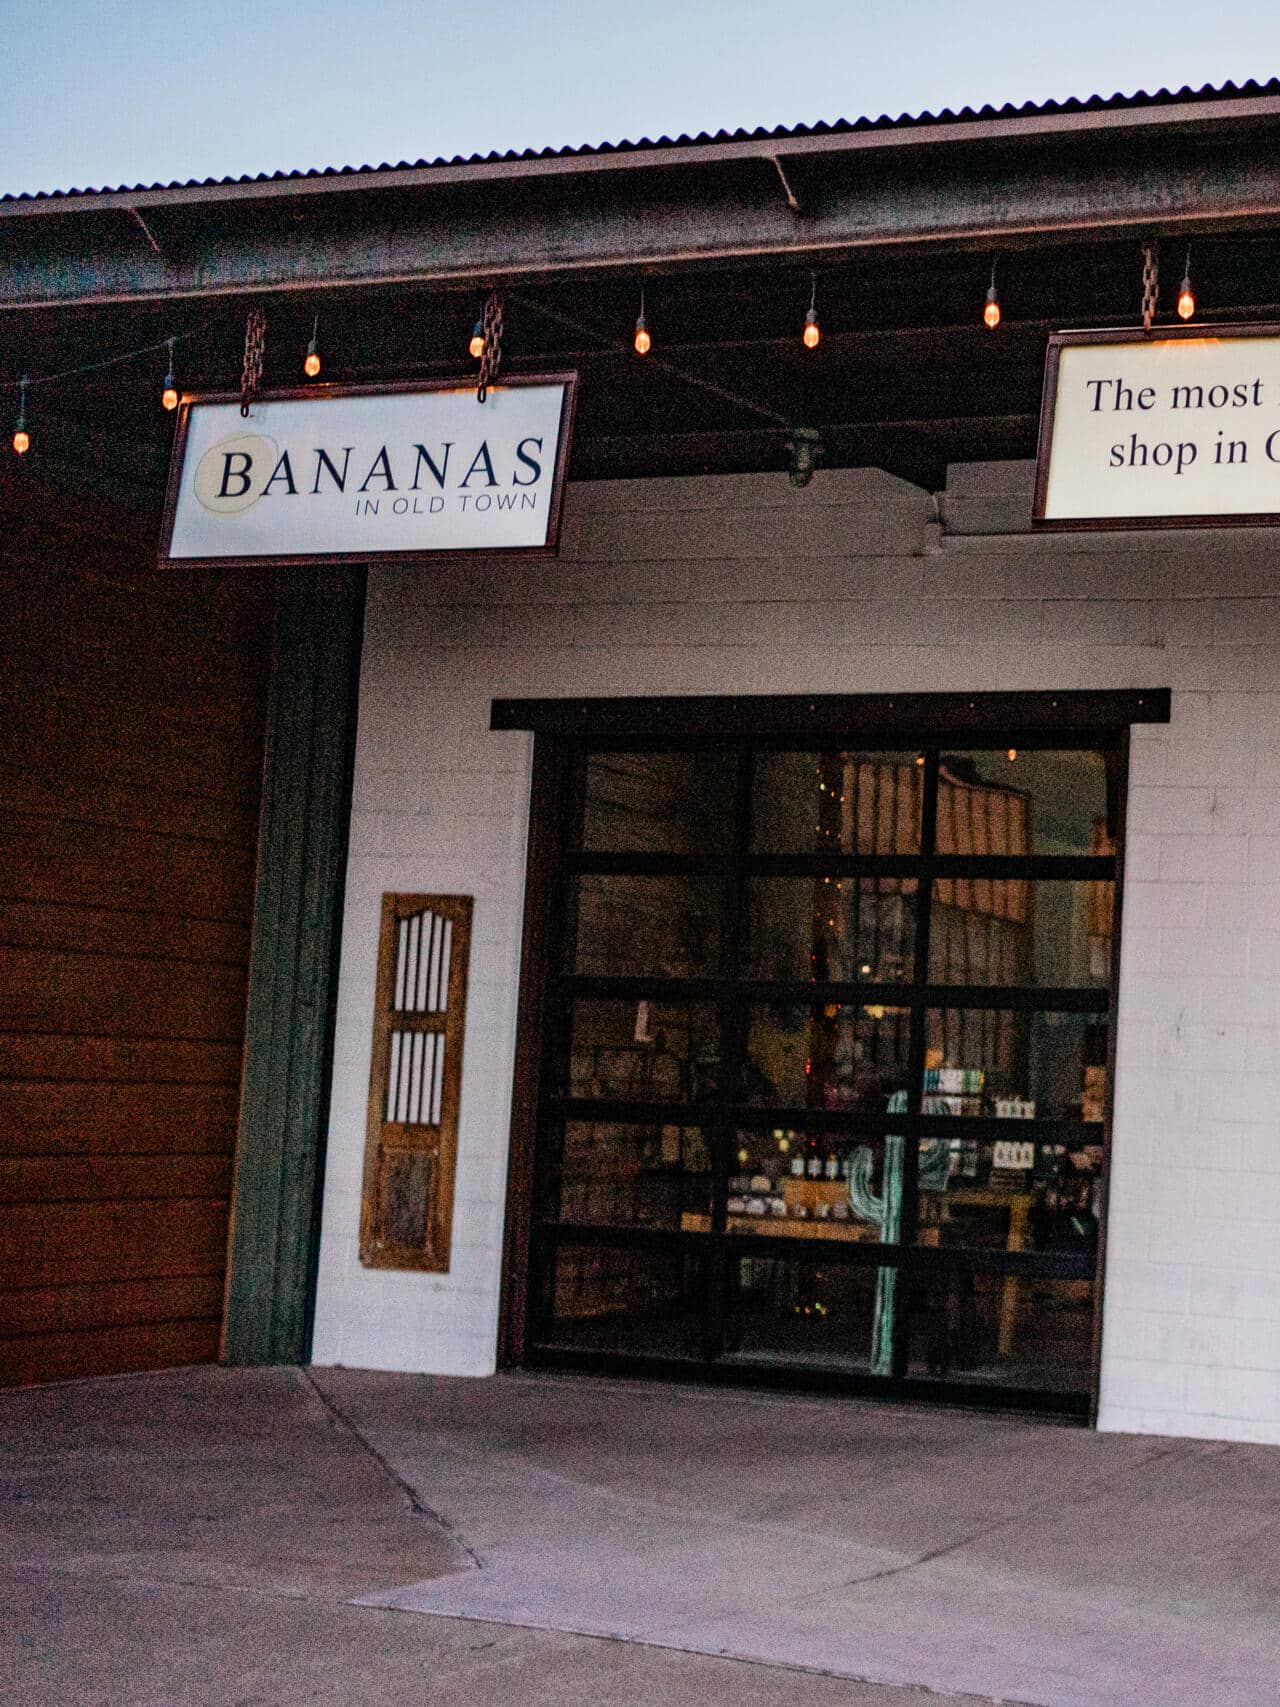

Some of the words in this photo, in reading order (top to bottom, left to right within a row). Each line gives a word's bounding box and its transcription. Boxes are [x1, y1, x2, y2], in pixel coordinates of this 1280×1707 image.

[1086, 378, 1156, 412] The
[1170, 377, 1265, 409] most
[214, 436, 544, 499] BANANAS
[1109, 433, 1198, 475] shop
[1213, 430, 1248, 465] in
[355, 499, 381, 516] IN
[392, 496, 445, 515] OLD
[458, 493, 538, 513] TOWN
